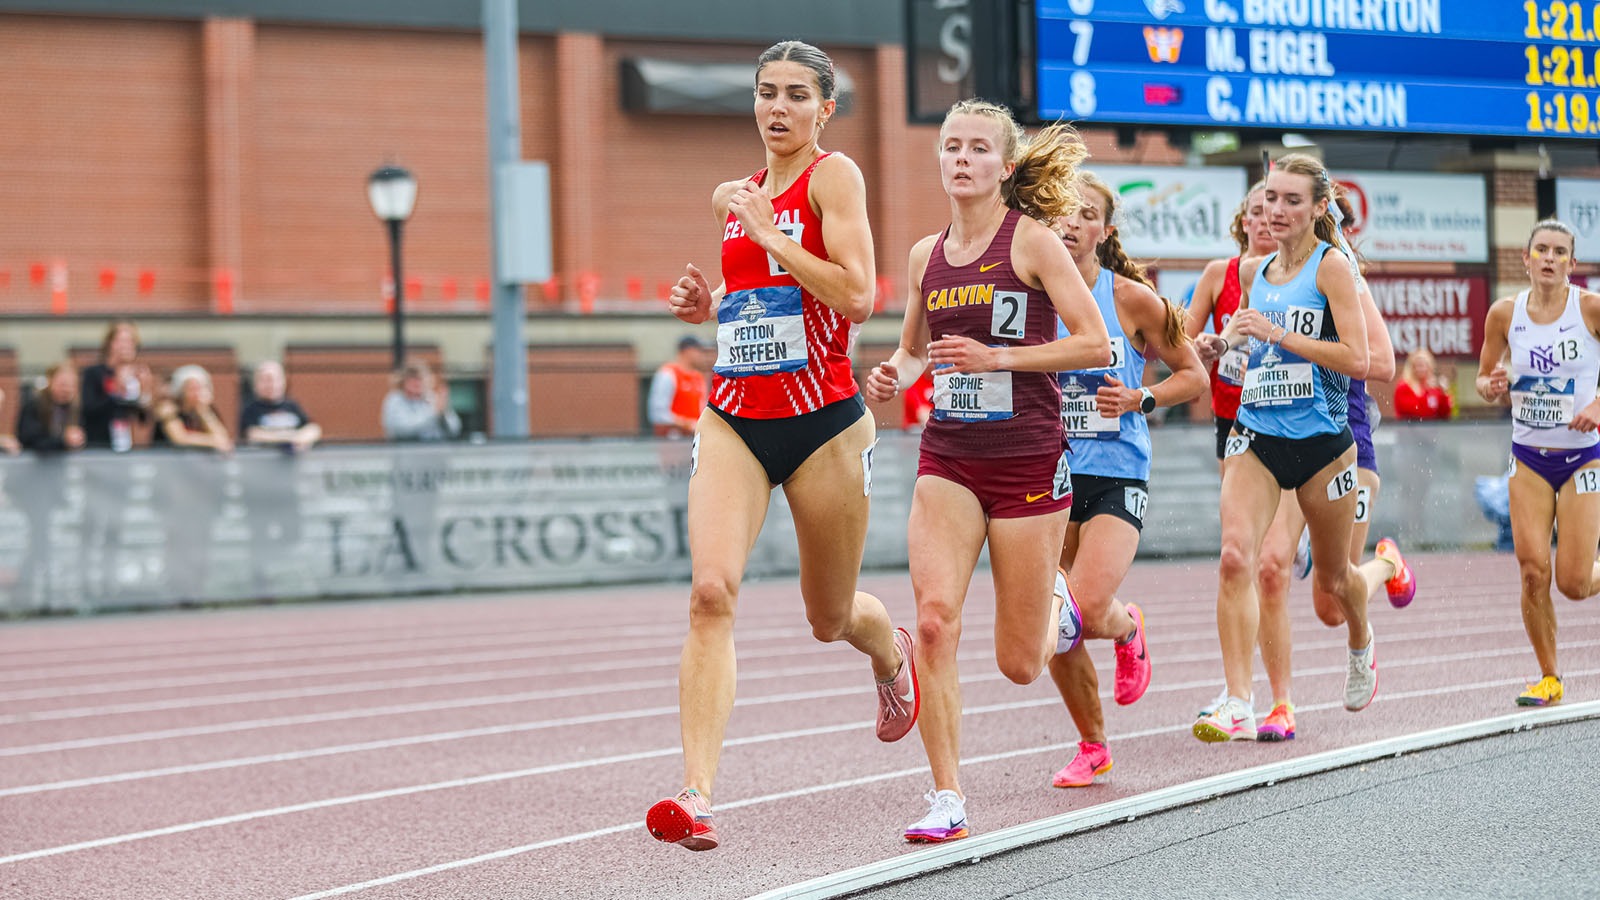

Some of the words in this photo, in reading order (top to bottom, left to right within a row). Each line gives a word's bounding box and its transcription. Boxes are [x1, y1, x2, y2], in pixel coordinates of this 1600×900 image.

[1243, 0, 1442, 33] BROTHERTON
[1069, 20, 1094, 66] 7
[1205, 27, 1246, 72] M.
[1249, 29, 1336, 76] EIGEL
[1069, 69, 1097, 117] 8
[1206, 75, 1241, 122] C.
[1245, 78, 1408, 128] ANDERSON
[927, 284, 995, 312] CALVIN
[1367, 279, 1470, 316] IVERSITY
[998, 296, 1019, 336] 2
[1291, 309, 1315, 336] 18
[734, 324, 774, 342] PEYTON
[1385, 318, 1472, 354] KSTORE
[729, 341, 788, 364] STEFFEN
[1558, 340, 1578, 361] 13
[948, 376, 984, 391] SOPHIE
[1257, 369, 1289, 383] CARTER
[950, 393, 982, 410] BULL
[1241, 382, 1312, 401] BROTHERTON
[1521, 396, 1562, 408] JOSEPHINE
[1062, 415, 1089, 430] NYE
[1520, 408, 1563, 422] DZIEDZIC
[1334, 470, 1353, 497] 18
[1579, 470, 1598, 493] 13
